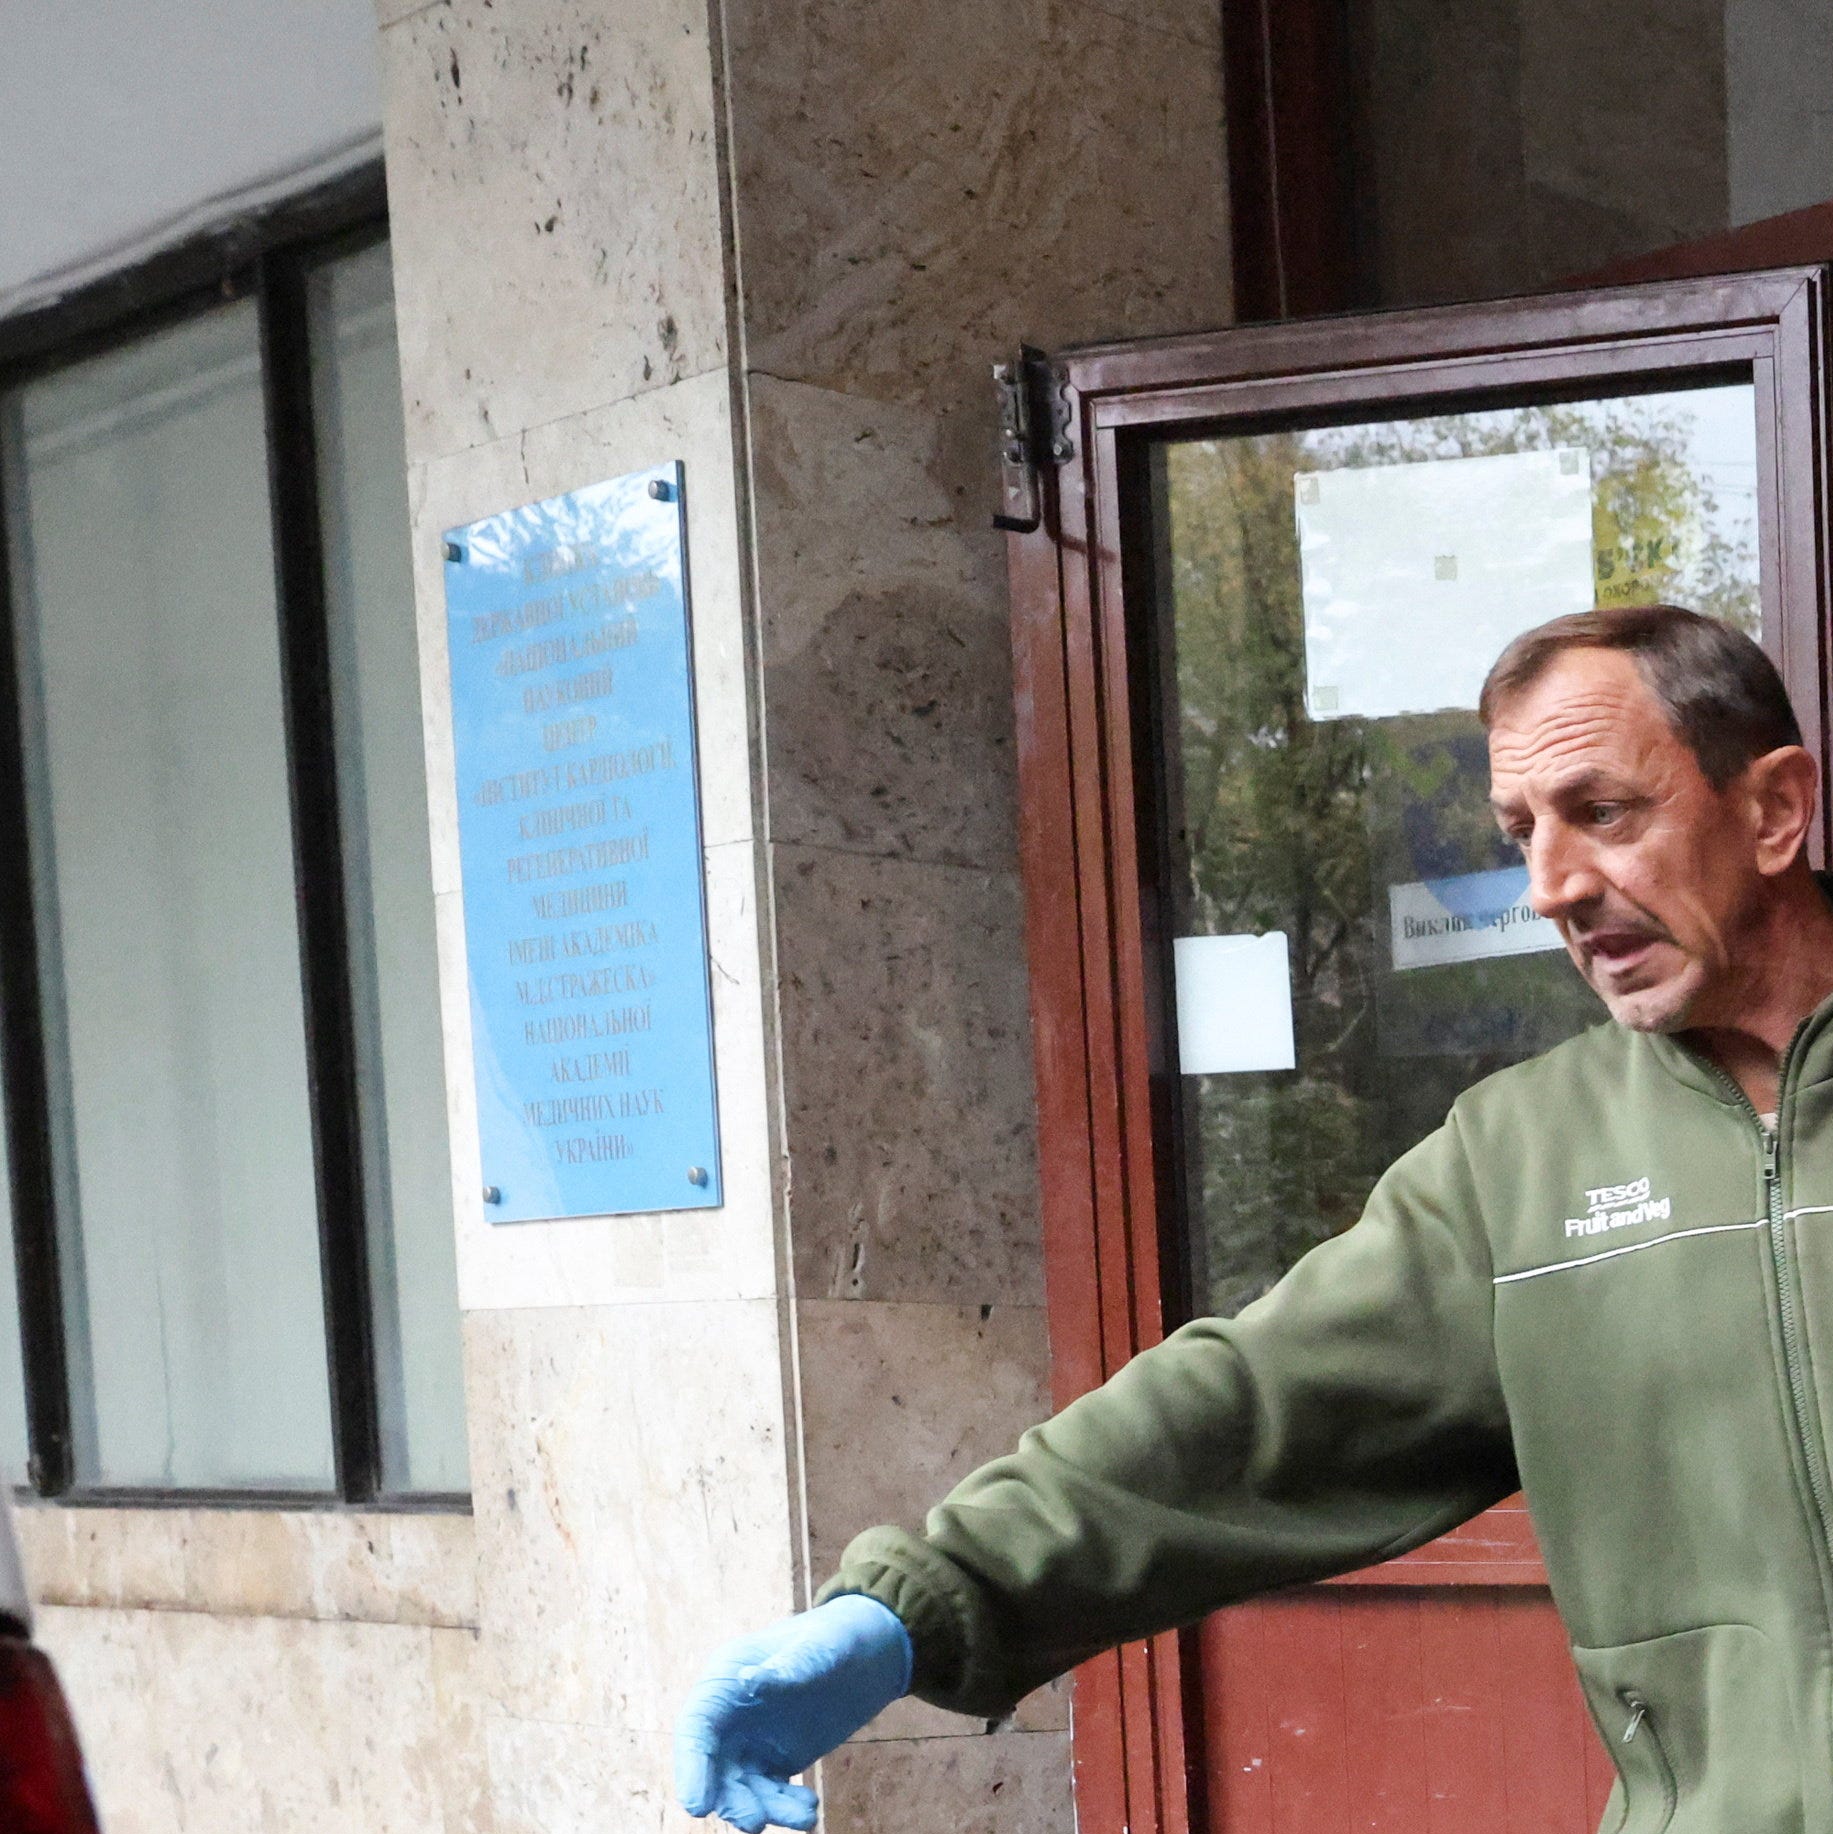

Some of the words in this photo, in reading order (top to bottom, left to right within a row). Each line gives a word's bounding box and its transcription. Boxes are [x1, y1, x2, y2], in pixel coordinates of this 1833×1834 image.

[611, 795, 632, 821] ТА
[531, 880, 628, 920] МЕДИЦИНИ
[508, 935, 556, 966] ІМЕНІ
[562, 920, 660, 957] АКАДЕМІКА
[524, 998, 652, 1046] НАЦІОНАЛЬНОЇ
[551, 1042, 630, 1083] АКАДЕМІЇ
[523, 1095, 615, 1128] МЕДИЧНИХ
[620, 1088, 665, 1118] НАУК
[1585, 1177, 1650, 1206] TESCO
[1564, 1211, 1609, 1237] Fruit
[1609, 1202, 1643, 1228] and
[1641, 1197, 1671, 1220] Veg
